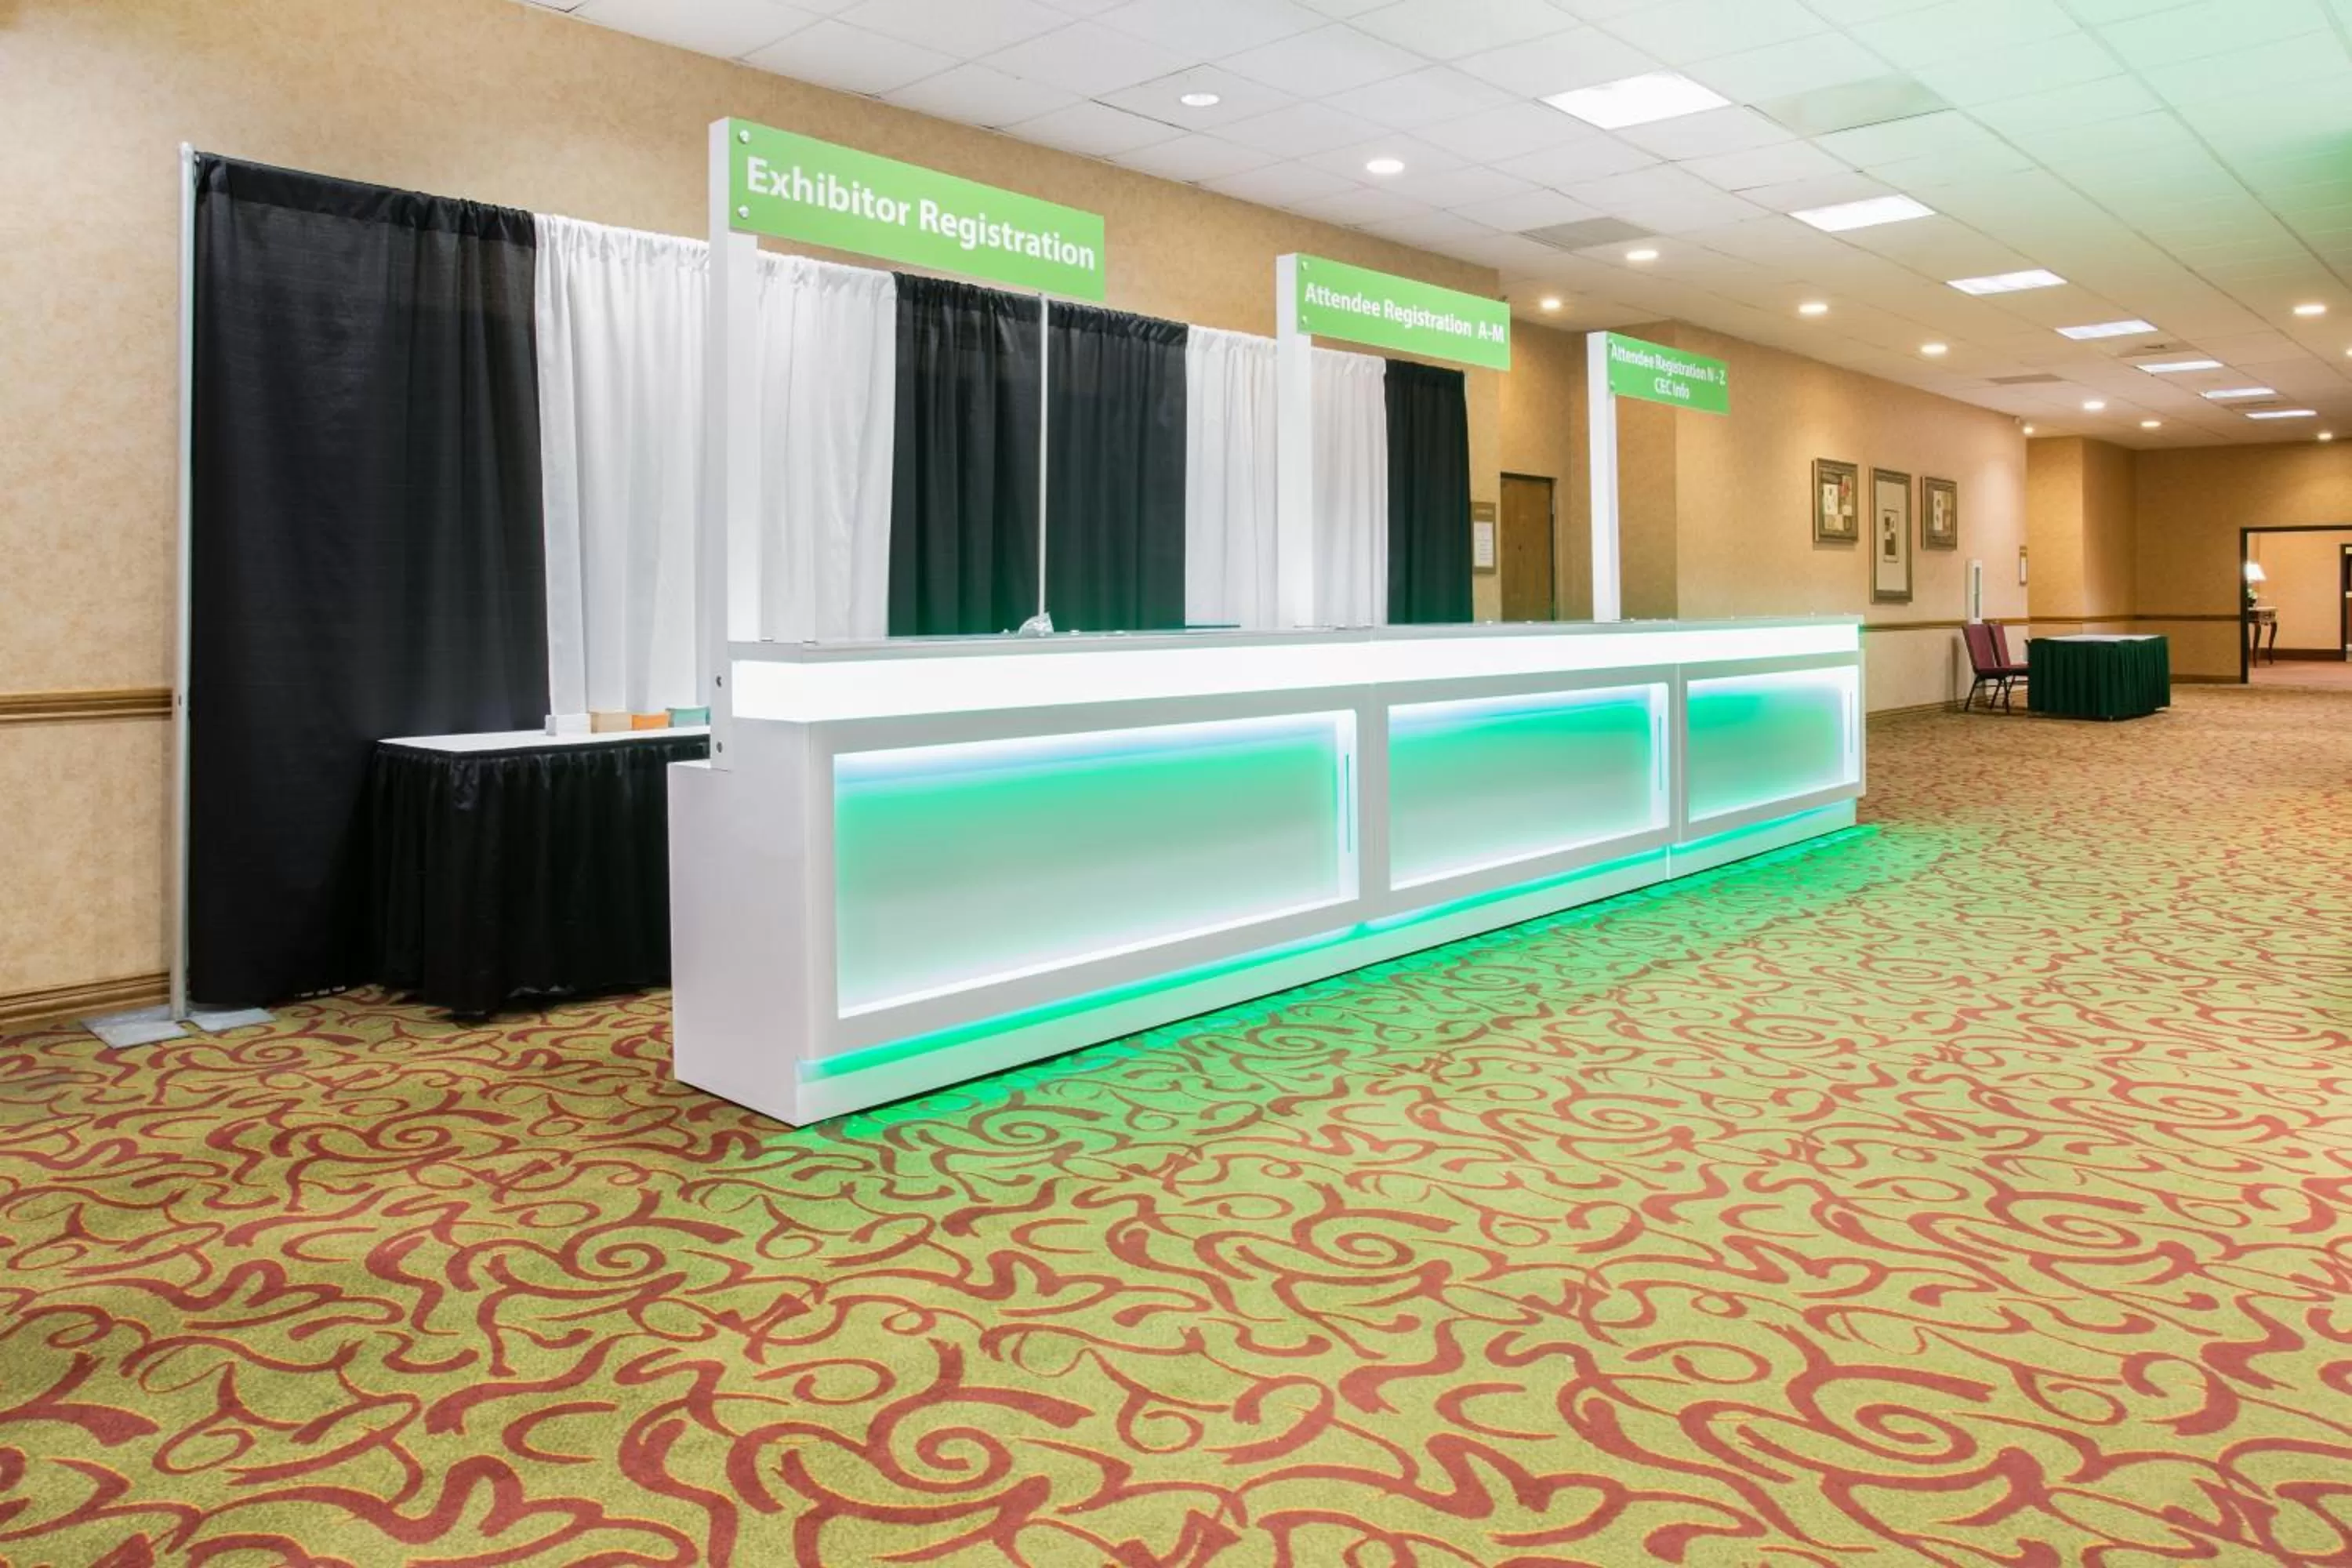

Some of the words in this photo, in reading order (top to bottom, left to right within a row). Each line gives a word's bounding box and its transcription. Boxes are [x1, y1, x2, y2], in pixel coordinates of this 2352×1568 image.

[747, 156, 910, 226] Exhibitor
[920, 199, 1095, 270] Registration
[1305, 282, 1381, 317] Attendee
[1384, 299, 1472, 338] Registration
[1478, 320, 1504, 343] A-M
[1611, 343, 1654, 368] Attendee
[1655, 354, 1706, 379] Registration
